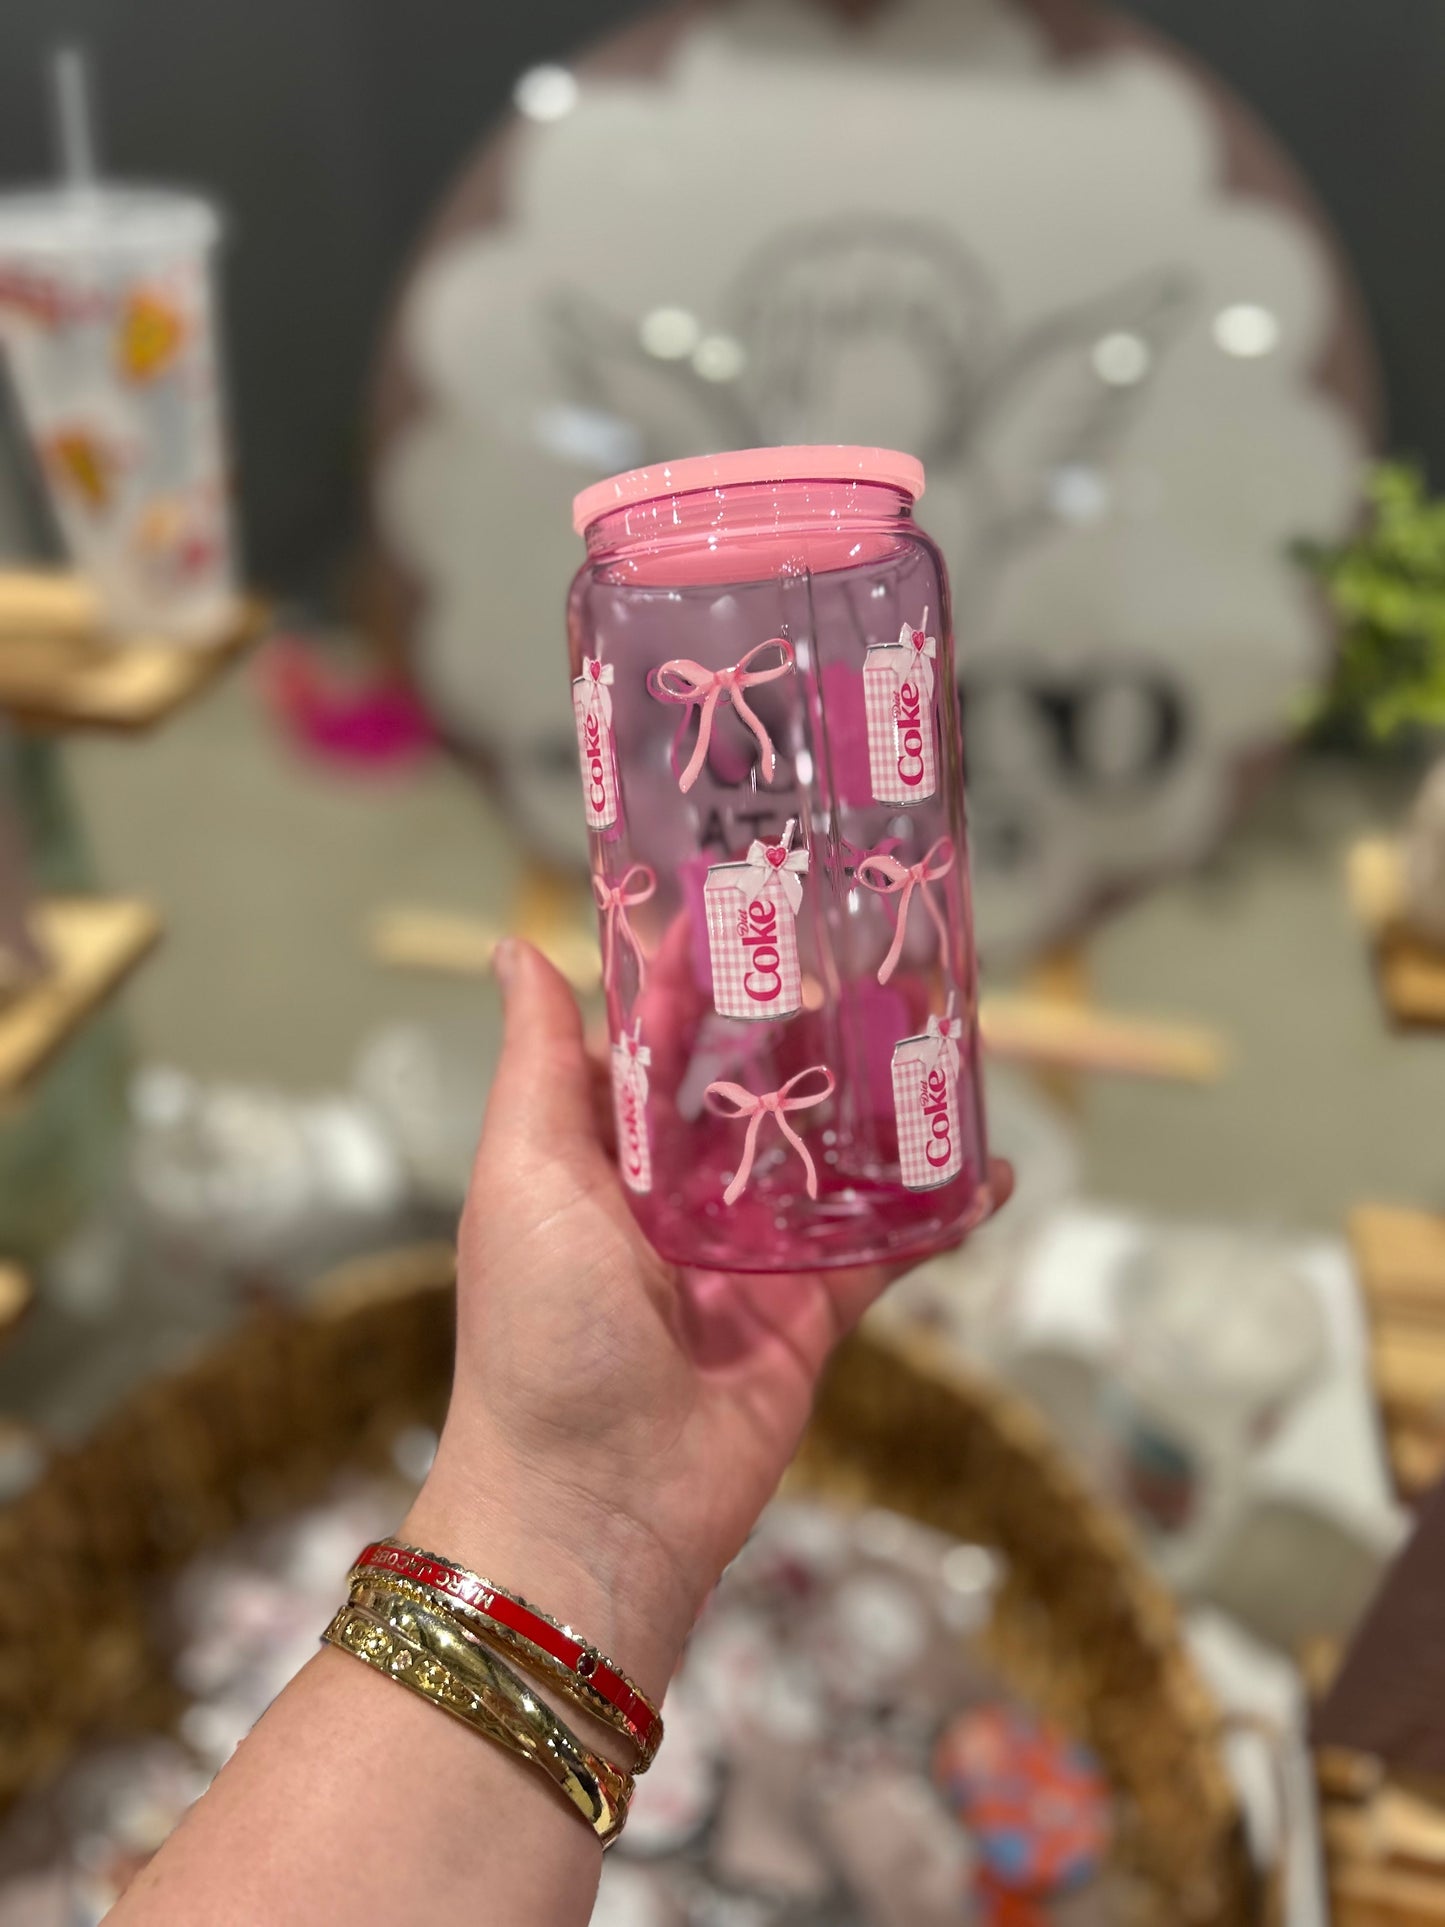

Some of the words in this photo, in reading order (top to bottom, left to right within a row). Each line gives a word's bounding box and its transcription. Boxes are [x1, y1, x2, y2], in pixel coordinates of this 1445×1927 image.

[586, 713, 606, 812] Coke
[897, 682, 924, 786] Coke
[736, 908, 749, 936] Diet
[742, 900, 782, 1002] Coke
[923, 1067, 951, 1167] Coke
[372, 1549, 432, 1577] JACOBS
[436, 1570, 495, 1610] MARC
